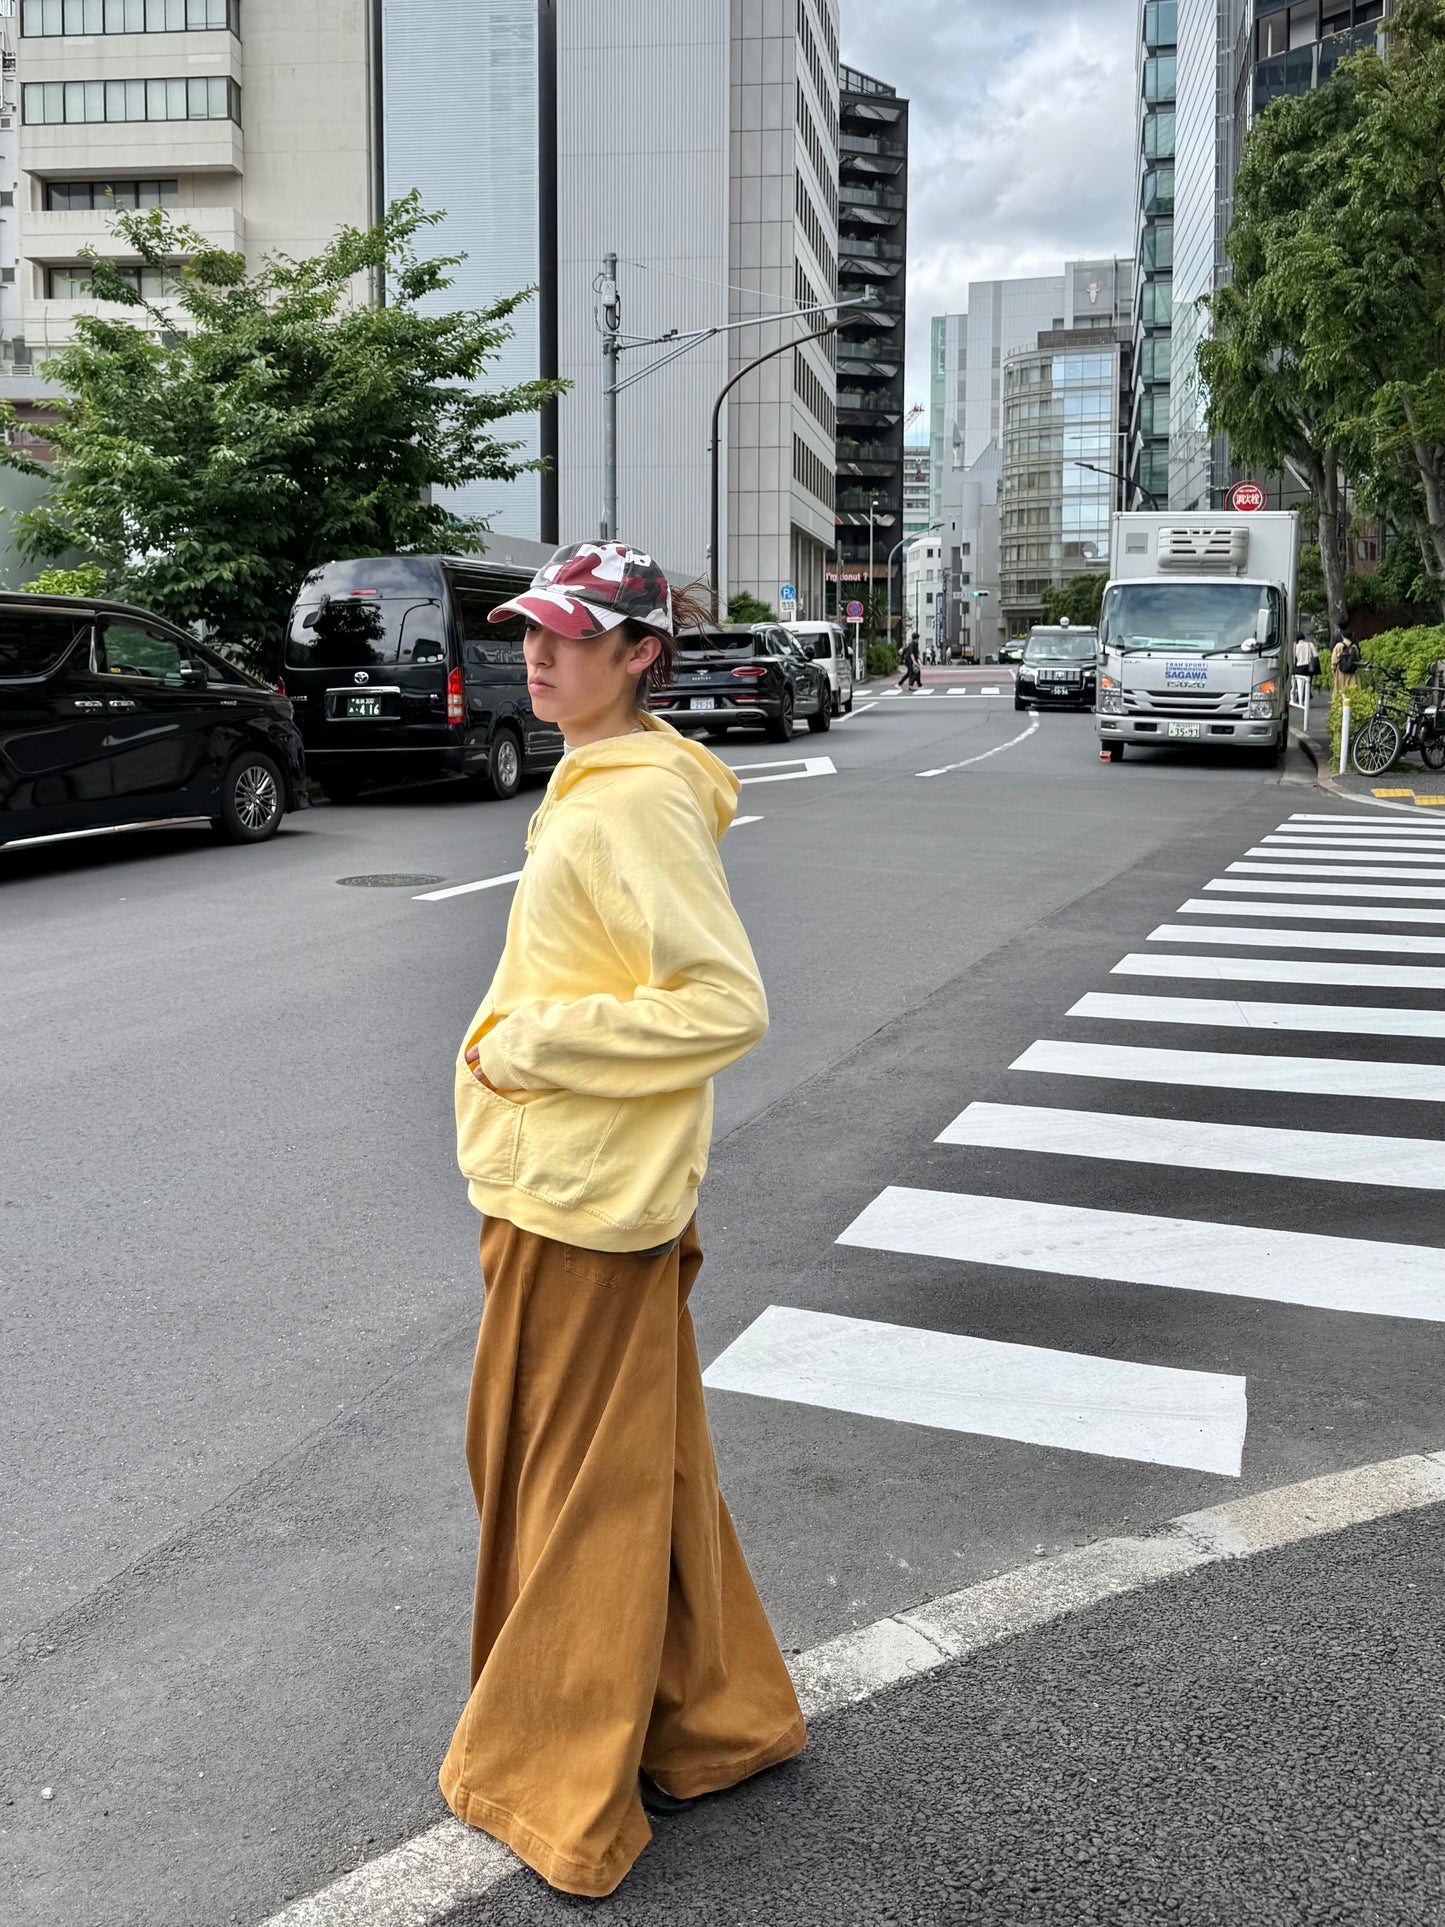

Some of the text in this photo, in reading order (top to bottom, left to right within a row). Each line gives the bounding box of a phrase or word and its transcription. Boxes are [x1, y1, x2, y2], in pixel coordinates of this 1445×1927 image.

[1236, 493, 1260, 505] 消火栓
[1165, 671, 1207, 680] SAGAWA
